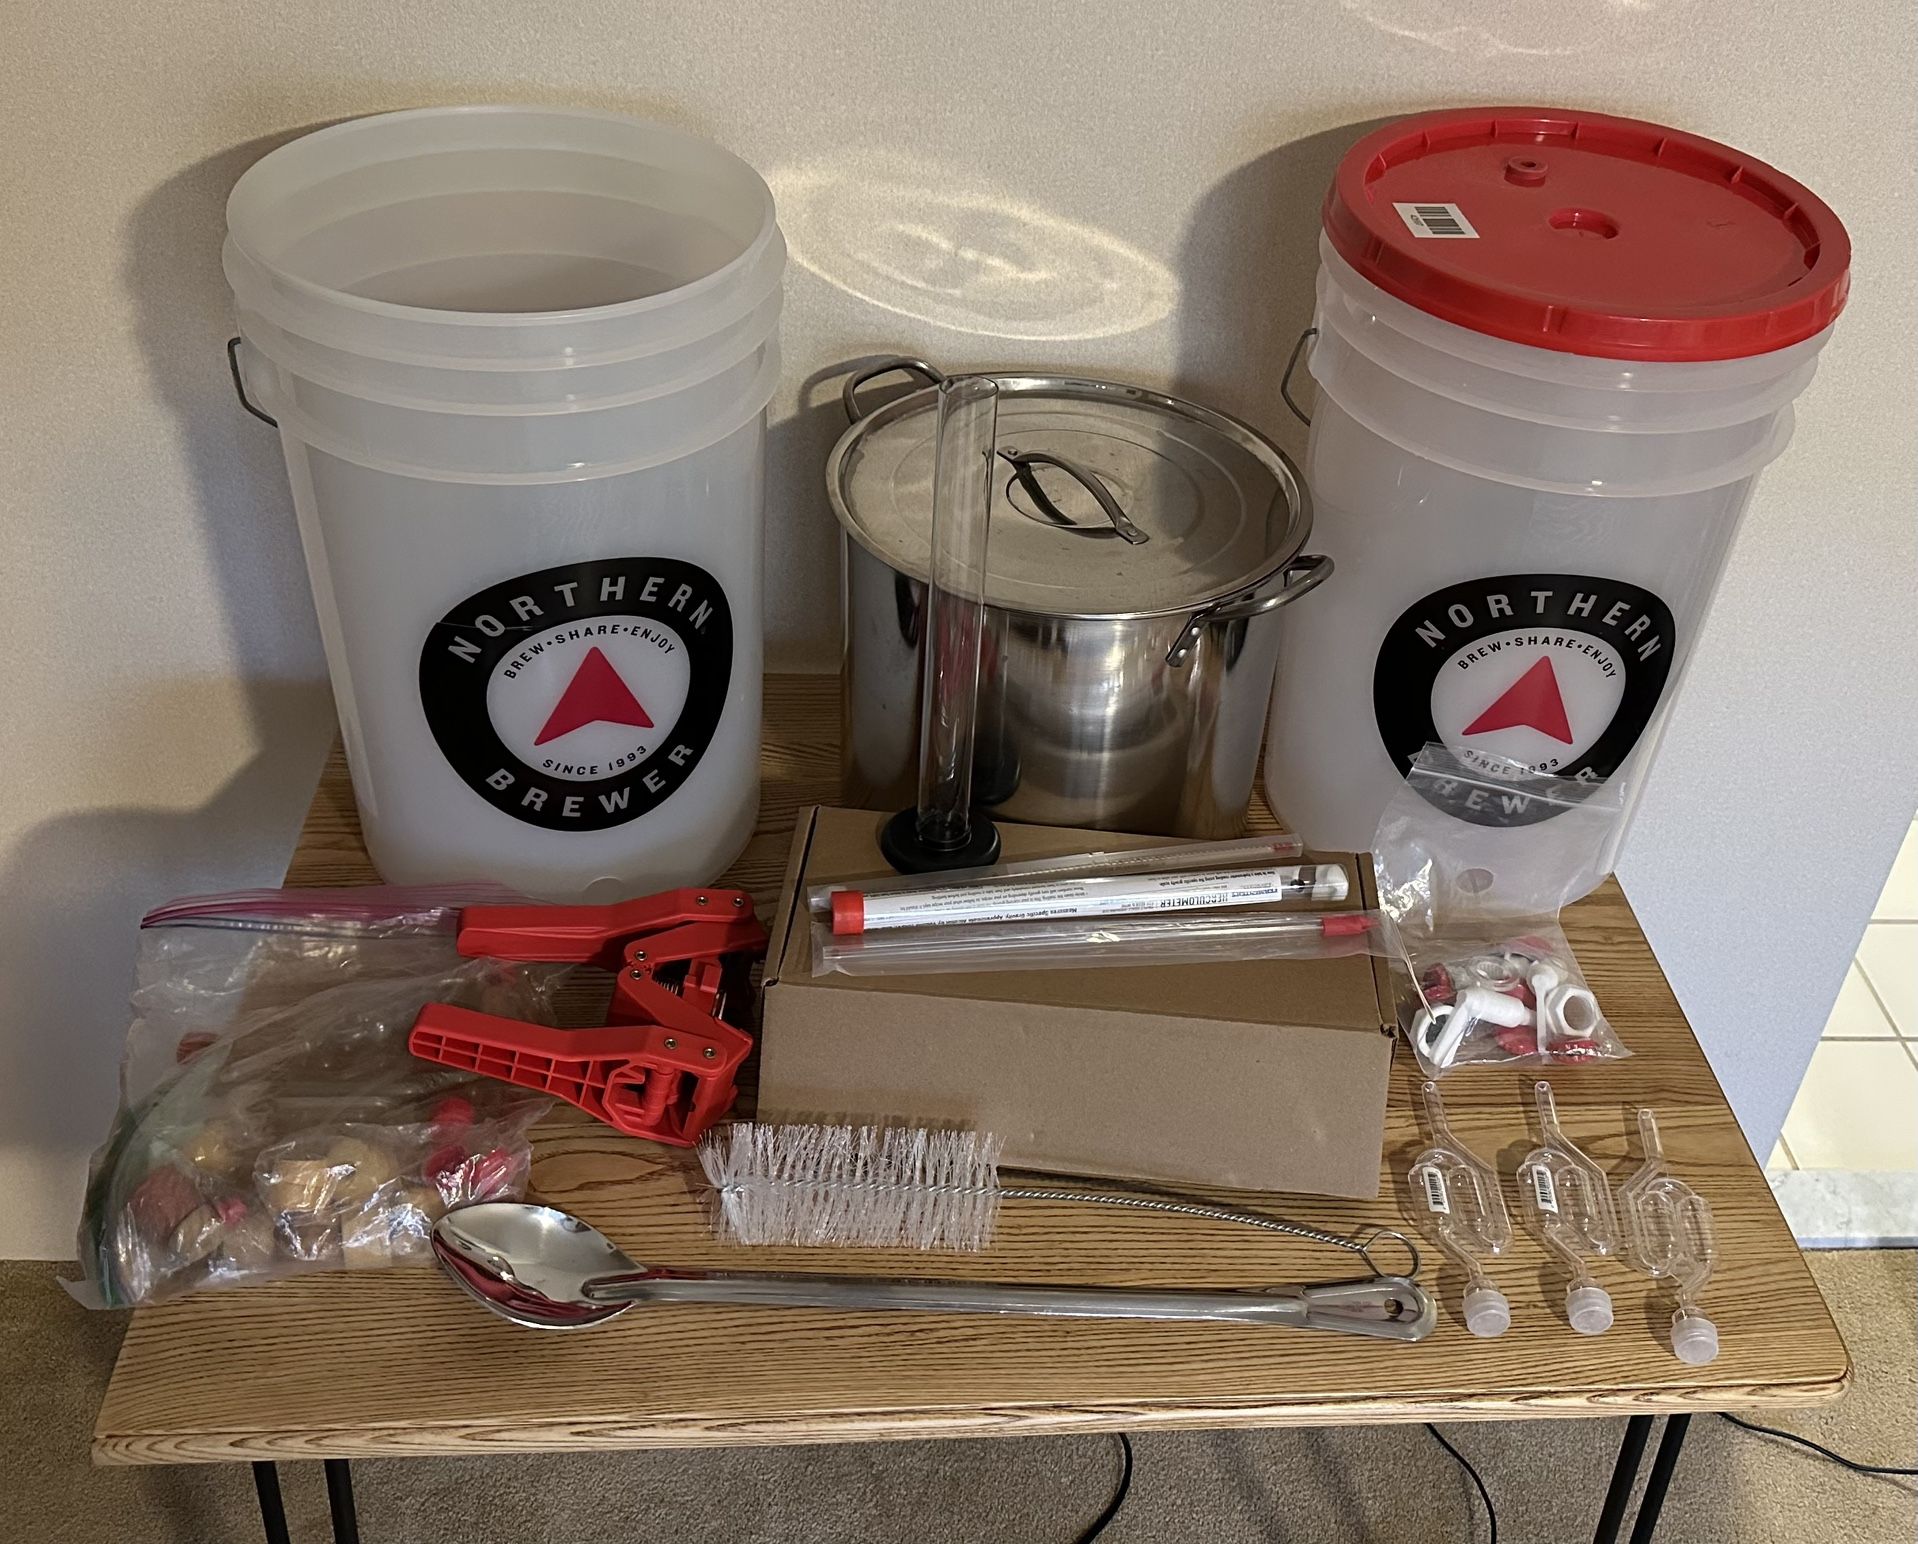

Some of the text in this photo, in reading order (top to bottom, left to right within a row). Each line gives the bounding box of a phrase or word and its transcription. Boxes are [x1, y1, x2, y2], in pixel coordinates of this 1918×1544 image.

[448, 576, 713, 664] NORTHERN
[1415, 590, 1661, 663] NORTHERN
[485, 744, 694, 818] BREWER
[543, 745, 648, 776] SINCE 1993
[1463, 750, 1511, 775] SINCE
